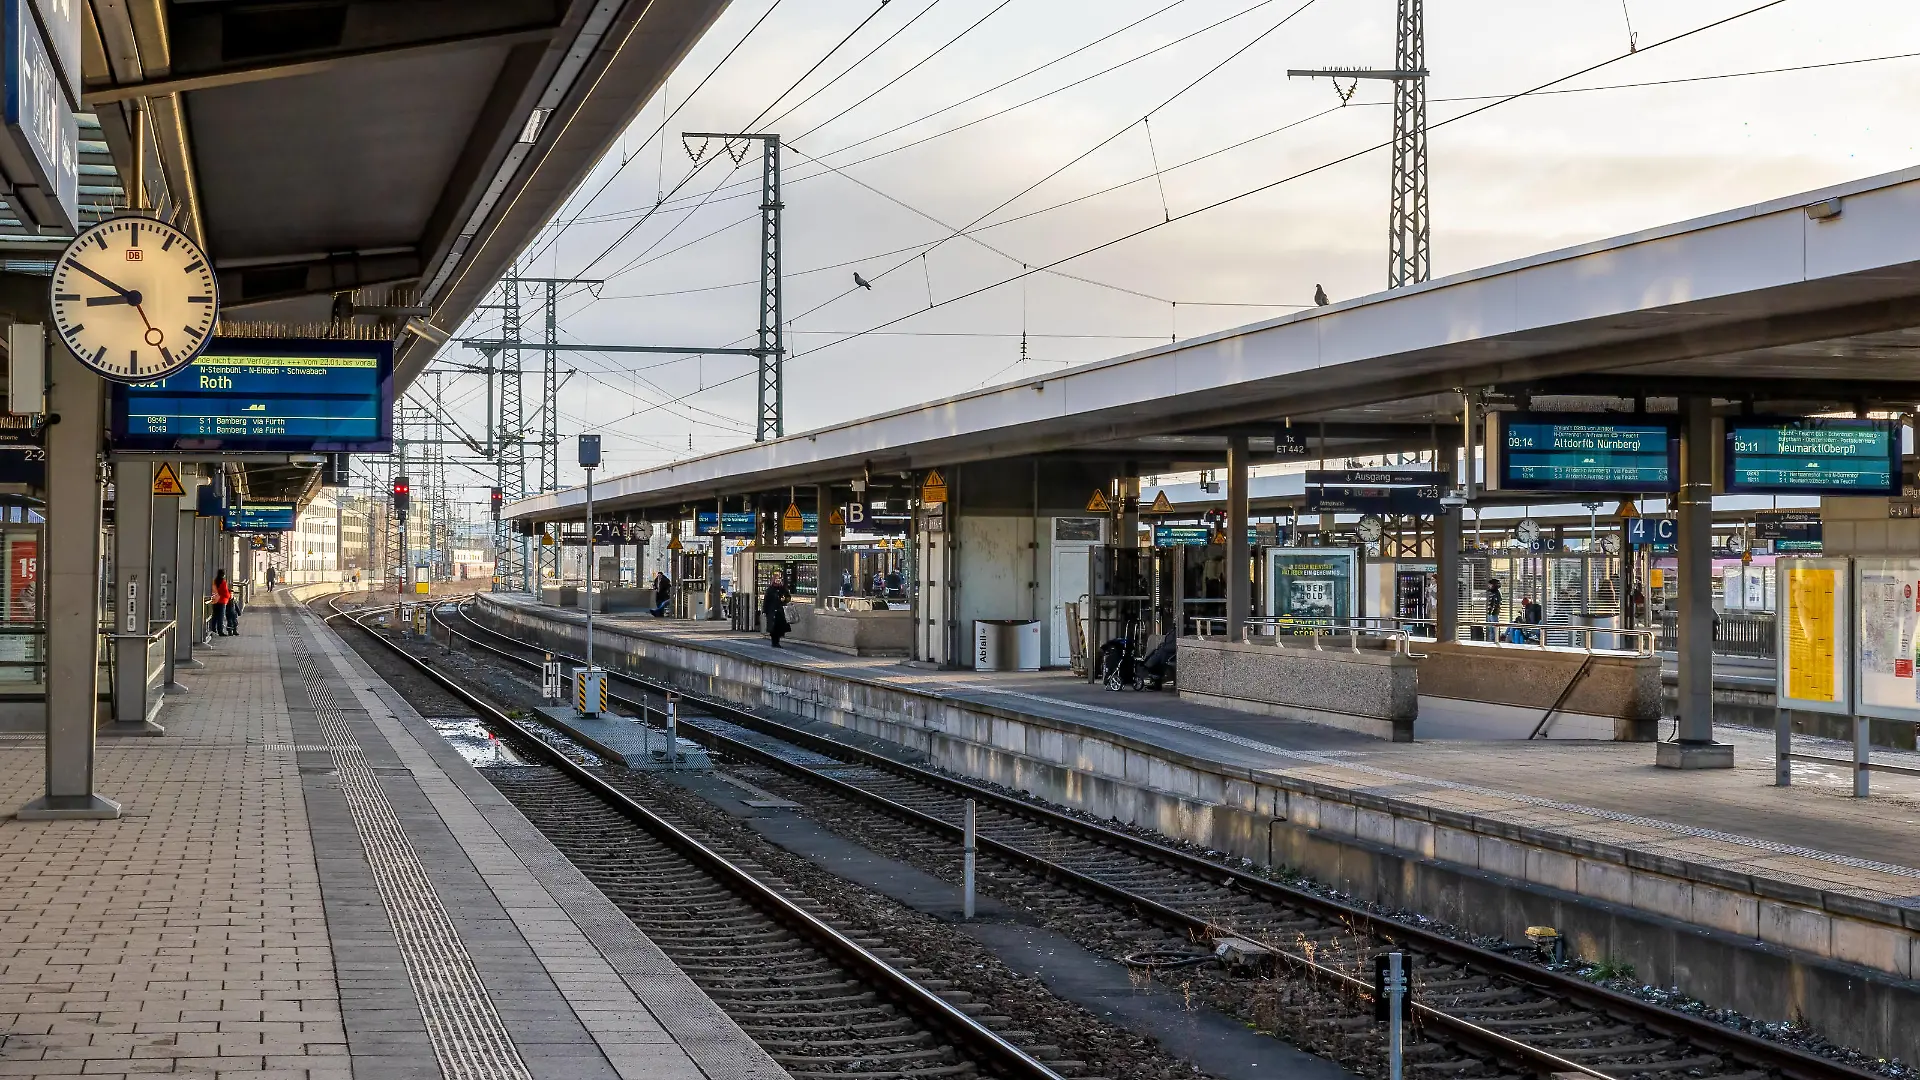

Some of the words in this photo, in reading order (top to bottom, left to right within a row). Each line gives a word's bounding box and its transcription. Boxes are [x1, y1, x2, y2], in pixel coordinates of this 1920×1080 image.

[127, 251, 141, 260] DB
[287, 367, 327, 375] Schwabach
[200, 375, 232, 389] Roth
[147, 416, 167, 424] 09:49
[216, 418, 247, 426] Bamberg
[148, 425, 167, 433] 10:49
[216, 426, 247, 434] Bamberg
[265, 426, 285, 434] Fürth
[1285, 435, 1295, 443] 1x
[1508, 438, 1533, 447] 09:14
[1554, 438, 1594, 448] Altdorf(b
[1597, 439, 1641, 451] Nürnberg)
[1276, 446, 1287, 454] ET
[1288, 445, 1304, 454] 442
[1734, 442, 1758, 451] 09:11
[1778, 442, 1856, 455] Neumarkt(Oberpf)
[1355, 472, 1391, 483] Ausgang
[1416, 489, 1439, 498] 4-23
[850, 503, 864, 522] B
[594, 525, 603, 536] 2
[610, 525, 621, 536] A
[1632, 519, 1646, 538] 4
[1658, 519, 1673, 539] C
[1547, 539, 1556, 550] C
[1300, 592, 1323, 600] GOLD
[403, 609, 412, 621] H
[979, 635, 987, 663] Abfall
